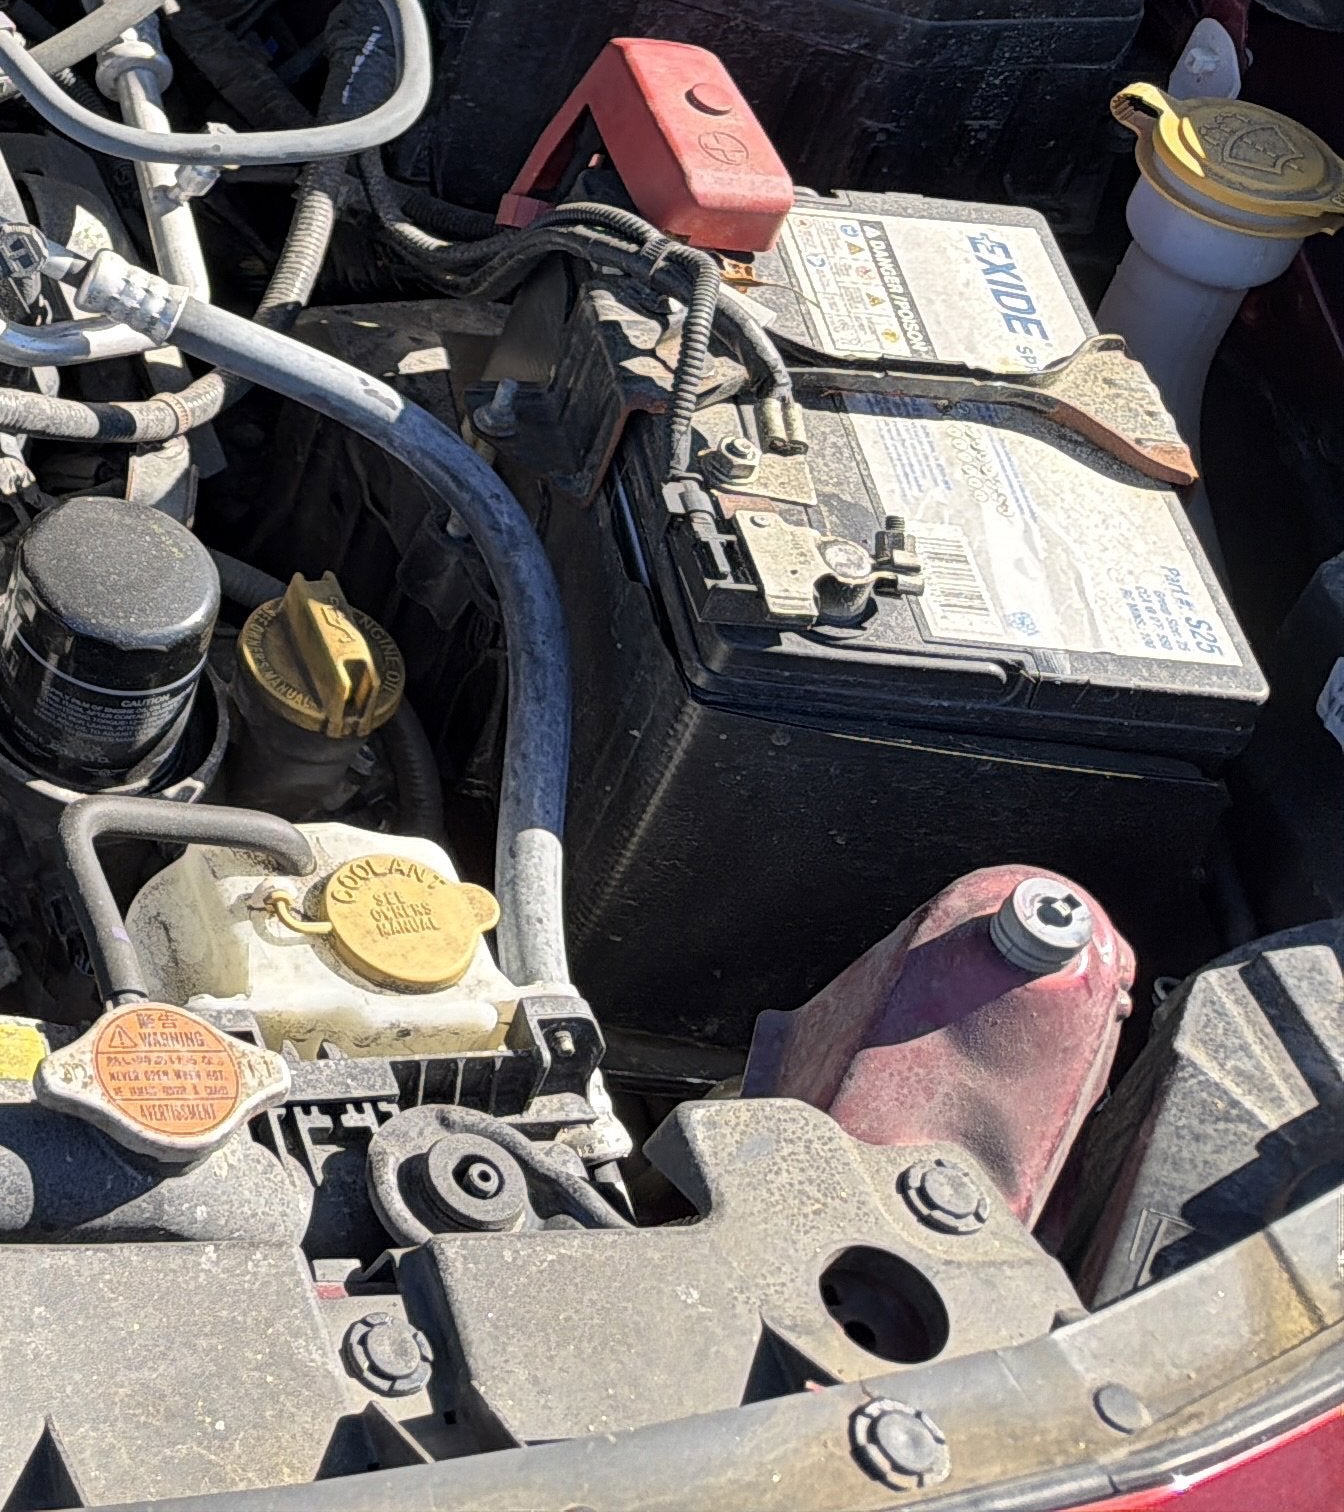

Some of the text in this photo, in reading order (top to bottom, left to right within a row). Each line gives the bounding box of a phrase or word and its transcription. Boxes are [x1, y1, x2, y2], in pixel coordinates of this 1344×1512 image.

[967, 232, 1050, 341] EXIDE
[1185, 616, 1224, 656] S25
[382, 669, 401, 695] OIL
[120, 693, 171, 708] CAUTION
[330, 858, 447, 904] COOLANT
[372, 890, 407, 907] SEE
[375, 916, 442, 938] MANUAL
[138, 1031, 205, 1048] WARNING
